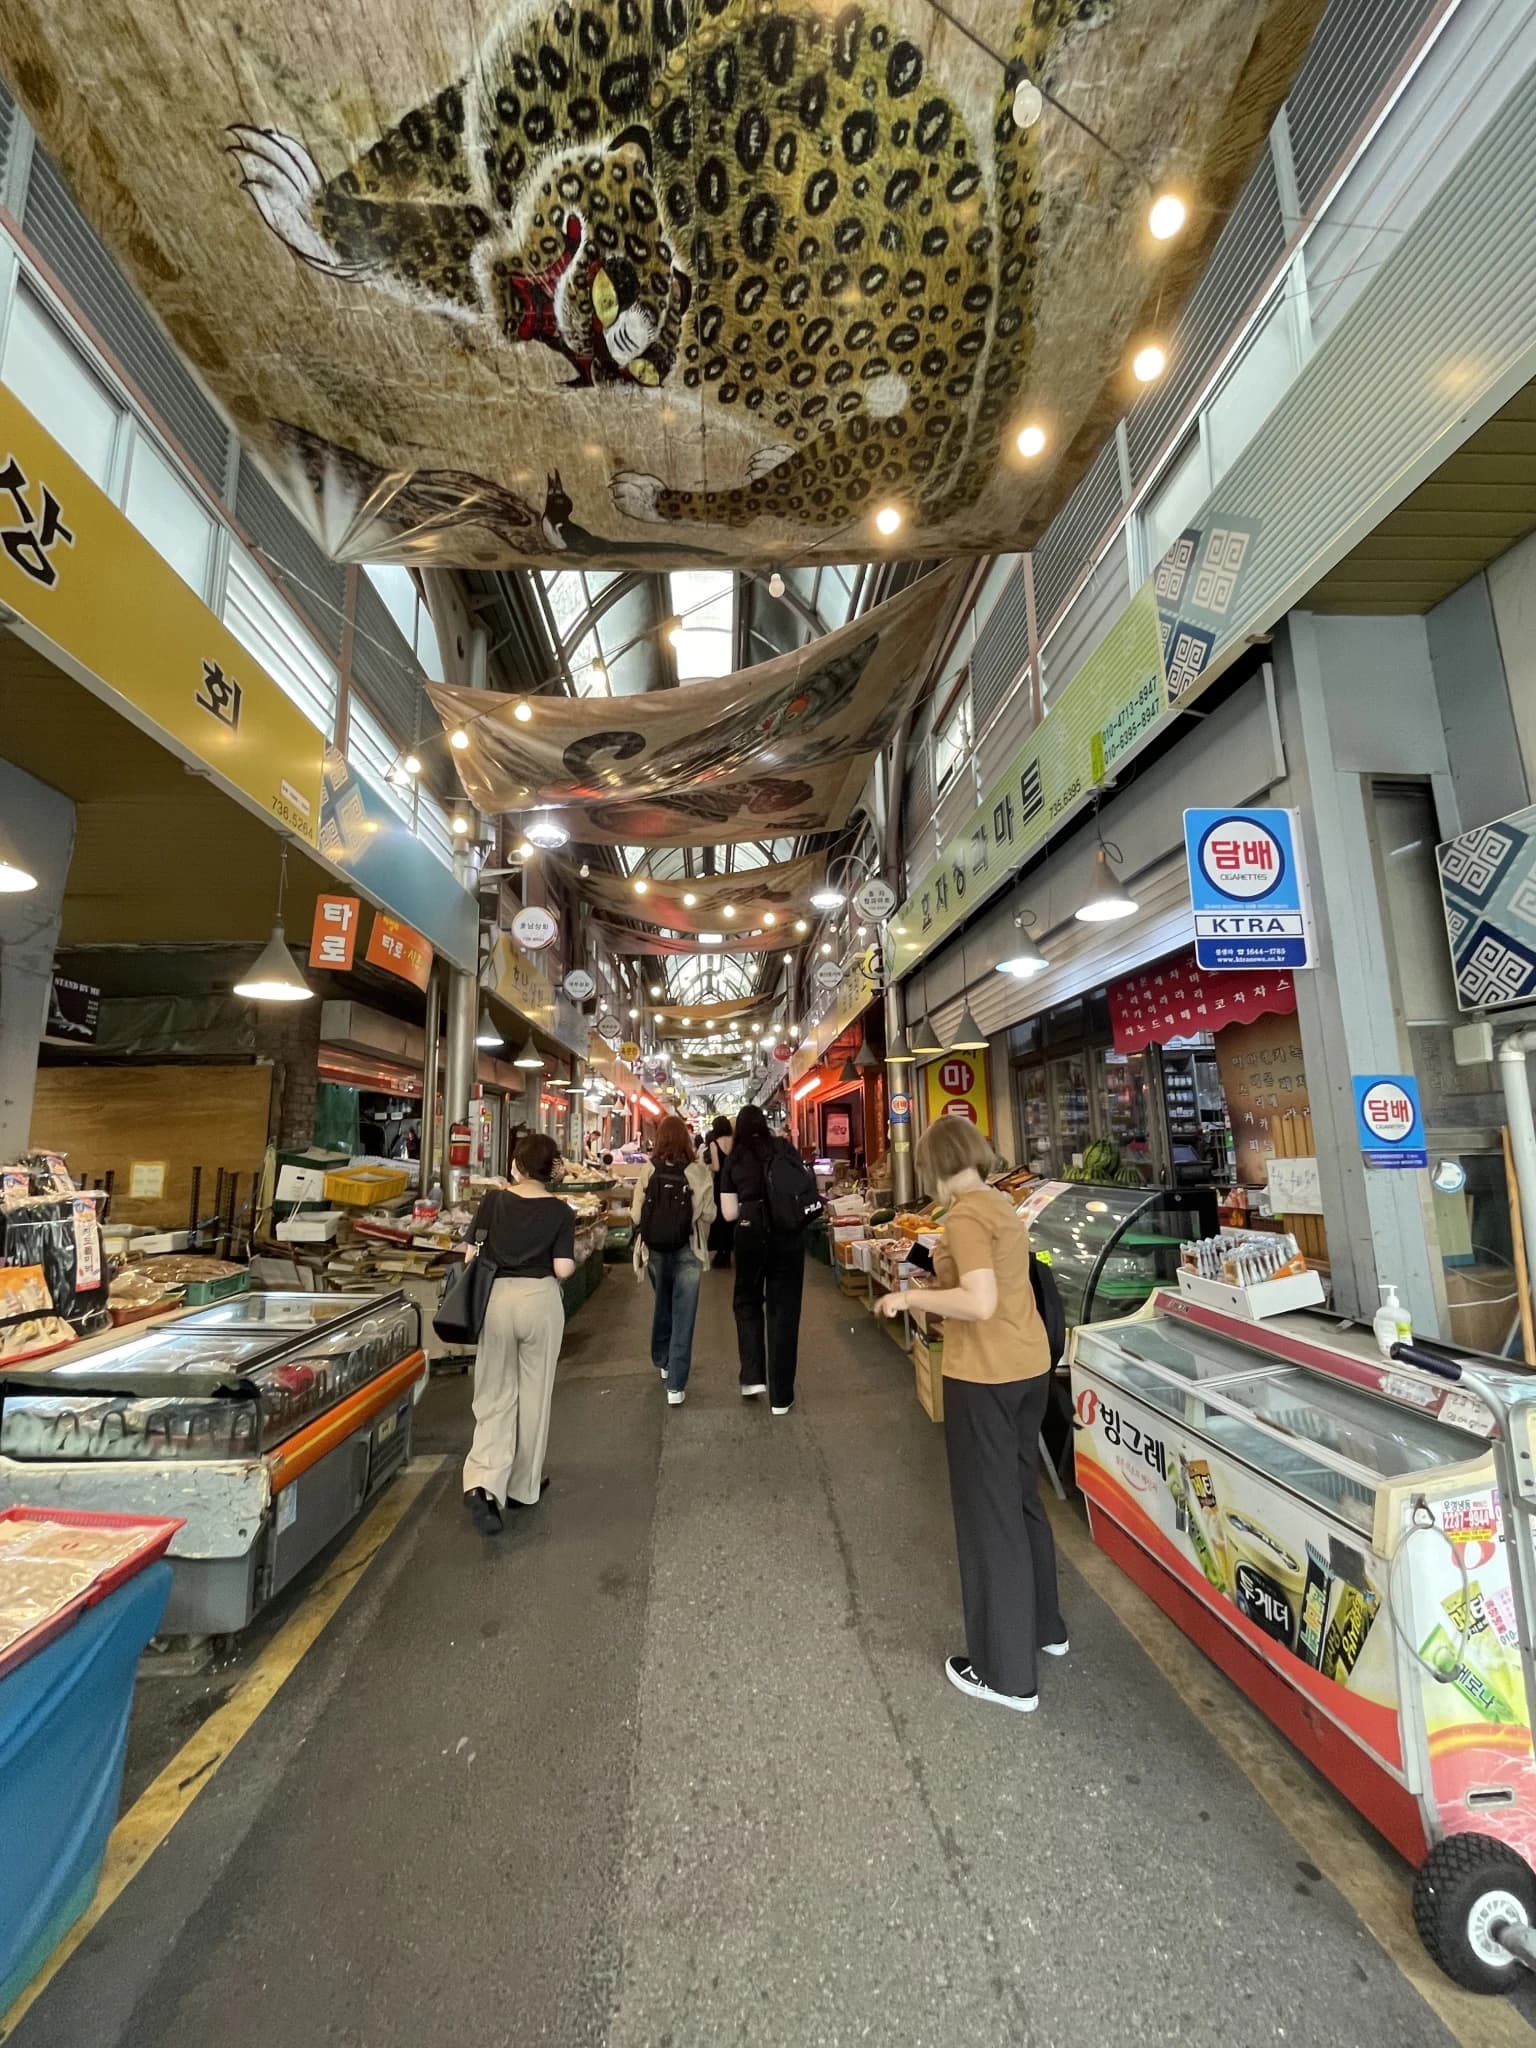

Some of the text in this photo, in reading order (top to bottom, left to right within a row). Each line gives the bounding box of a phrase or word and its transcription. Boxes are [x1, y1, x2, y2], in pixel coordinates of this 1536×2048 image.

[1211, 840, 1273, 870] 담배
[319, 902, 353, 963] 타로
[1212, 918, 1286, 934] KTRA
[1368, 1100, 1409, 1122] 담배
[1100, 1403, 1167, 1482] 빙그레
[1239, 1569, 1289, 1632] 투게더
